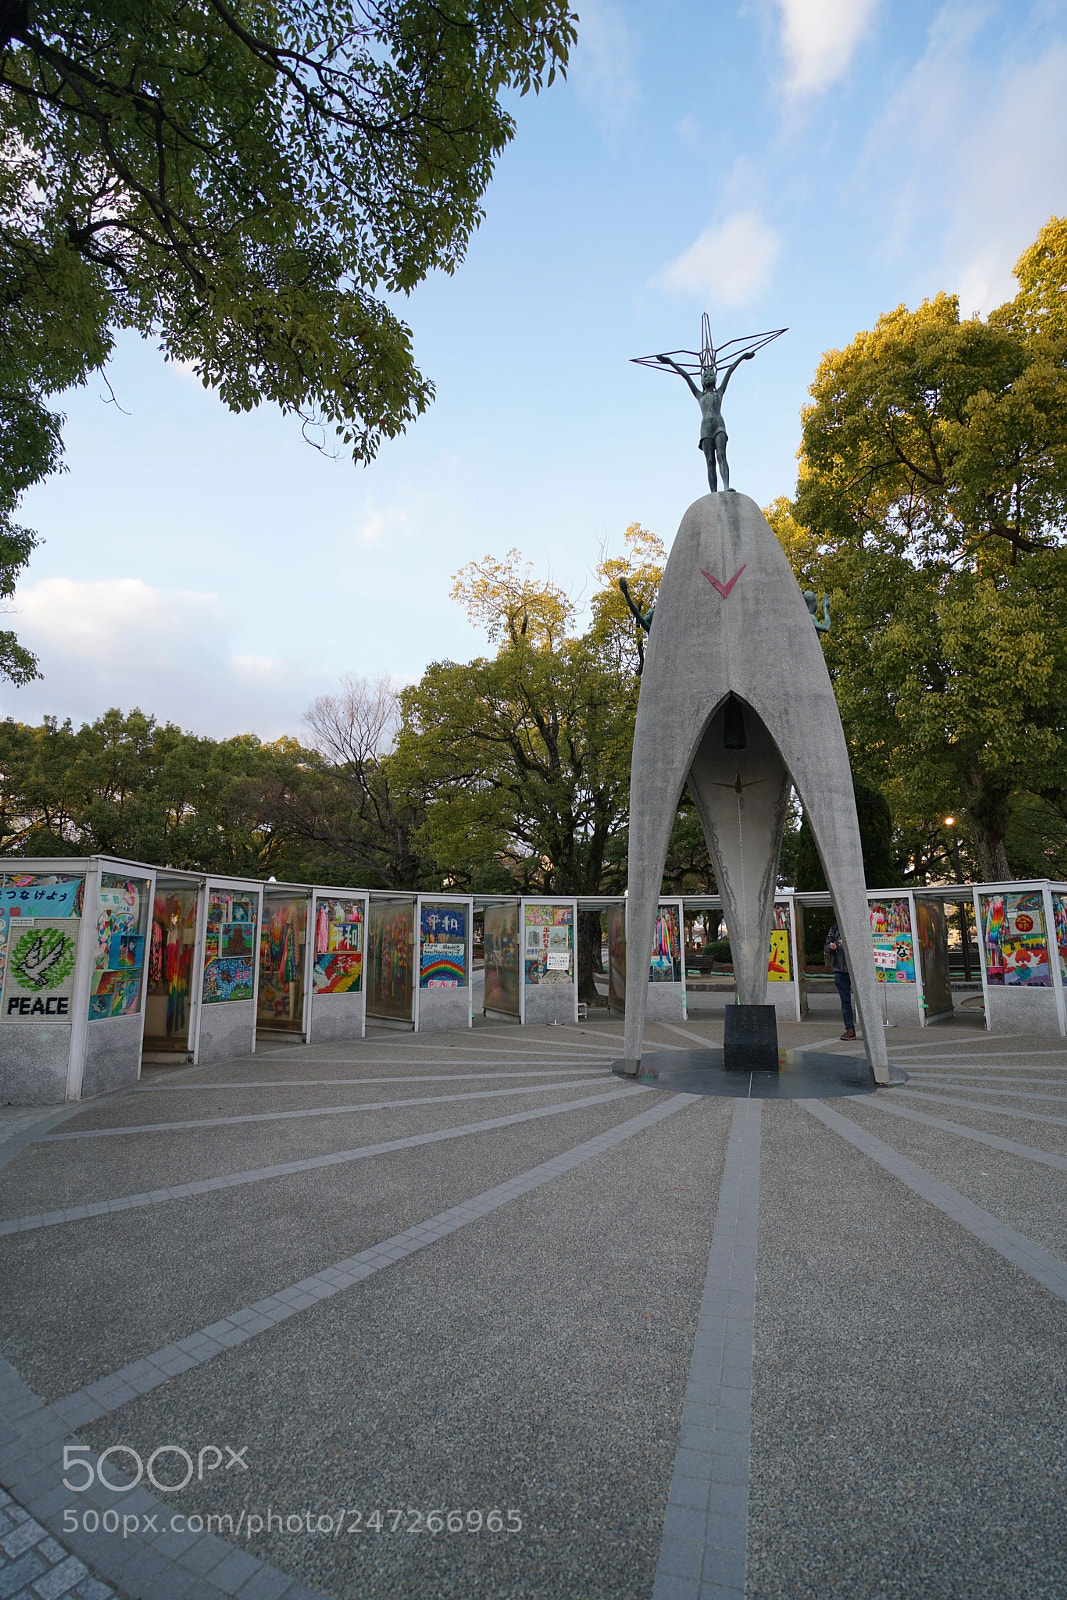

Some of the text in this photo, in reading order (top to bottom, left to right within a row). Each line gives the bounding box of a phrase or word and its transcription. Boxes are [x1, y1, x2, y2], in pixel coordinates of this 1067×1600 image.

[0, 890, 67, 902] つなげよう
[7, 997, 69, 1015] PEACE
